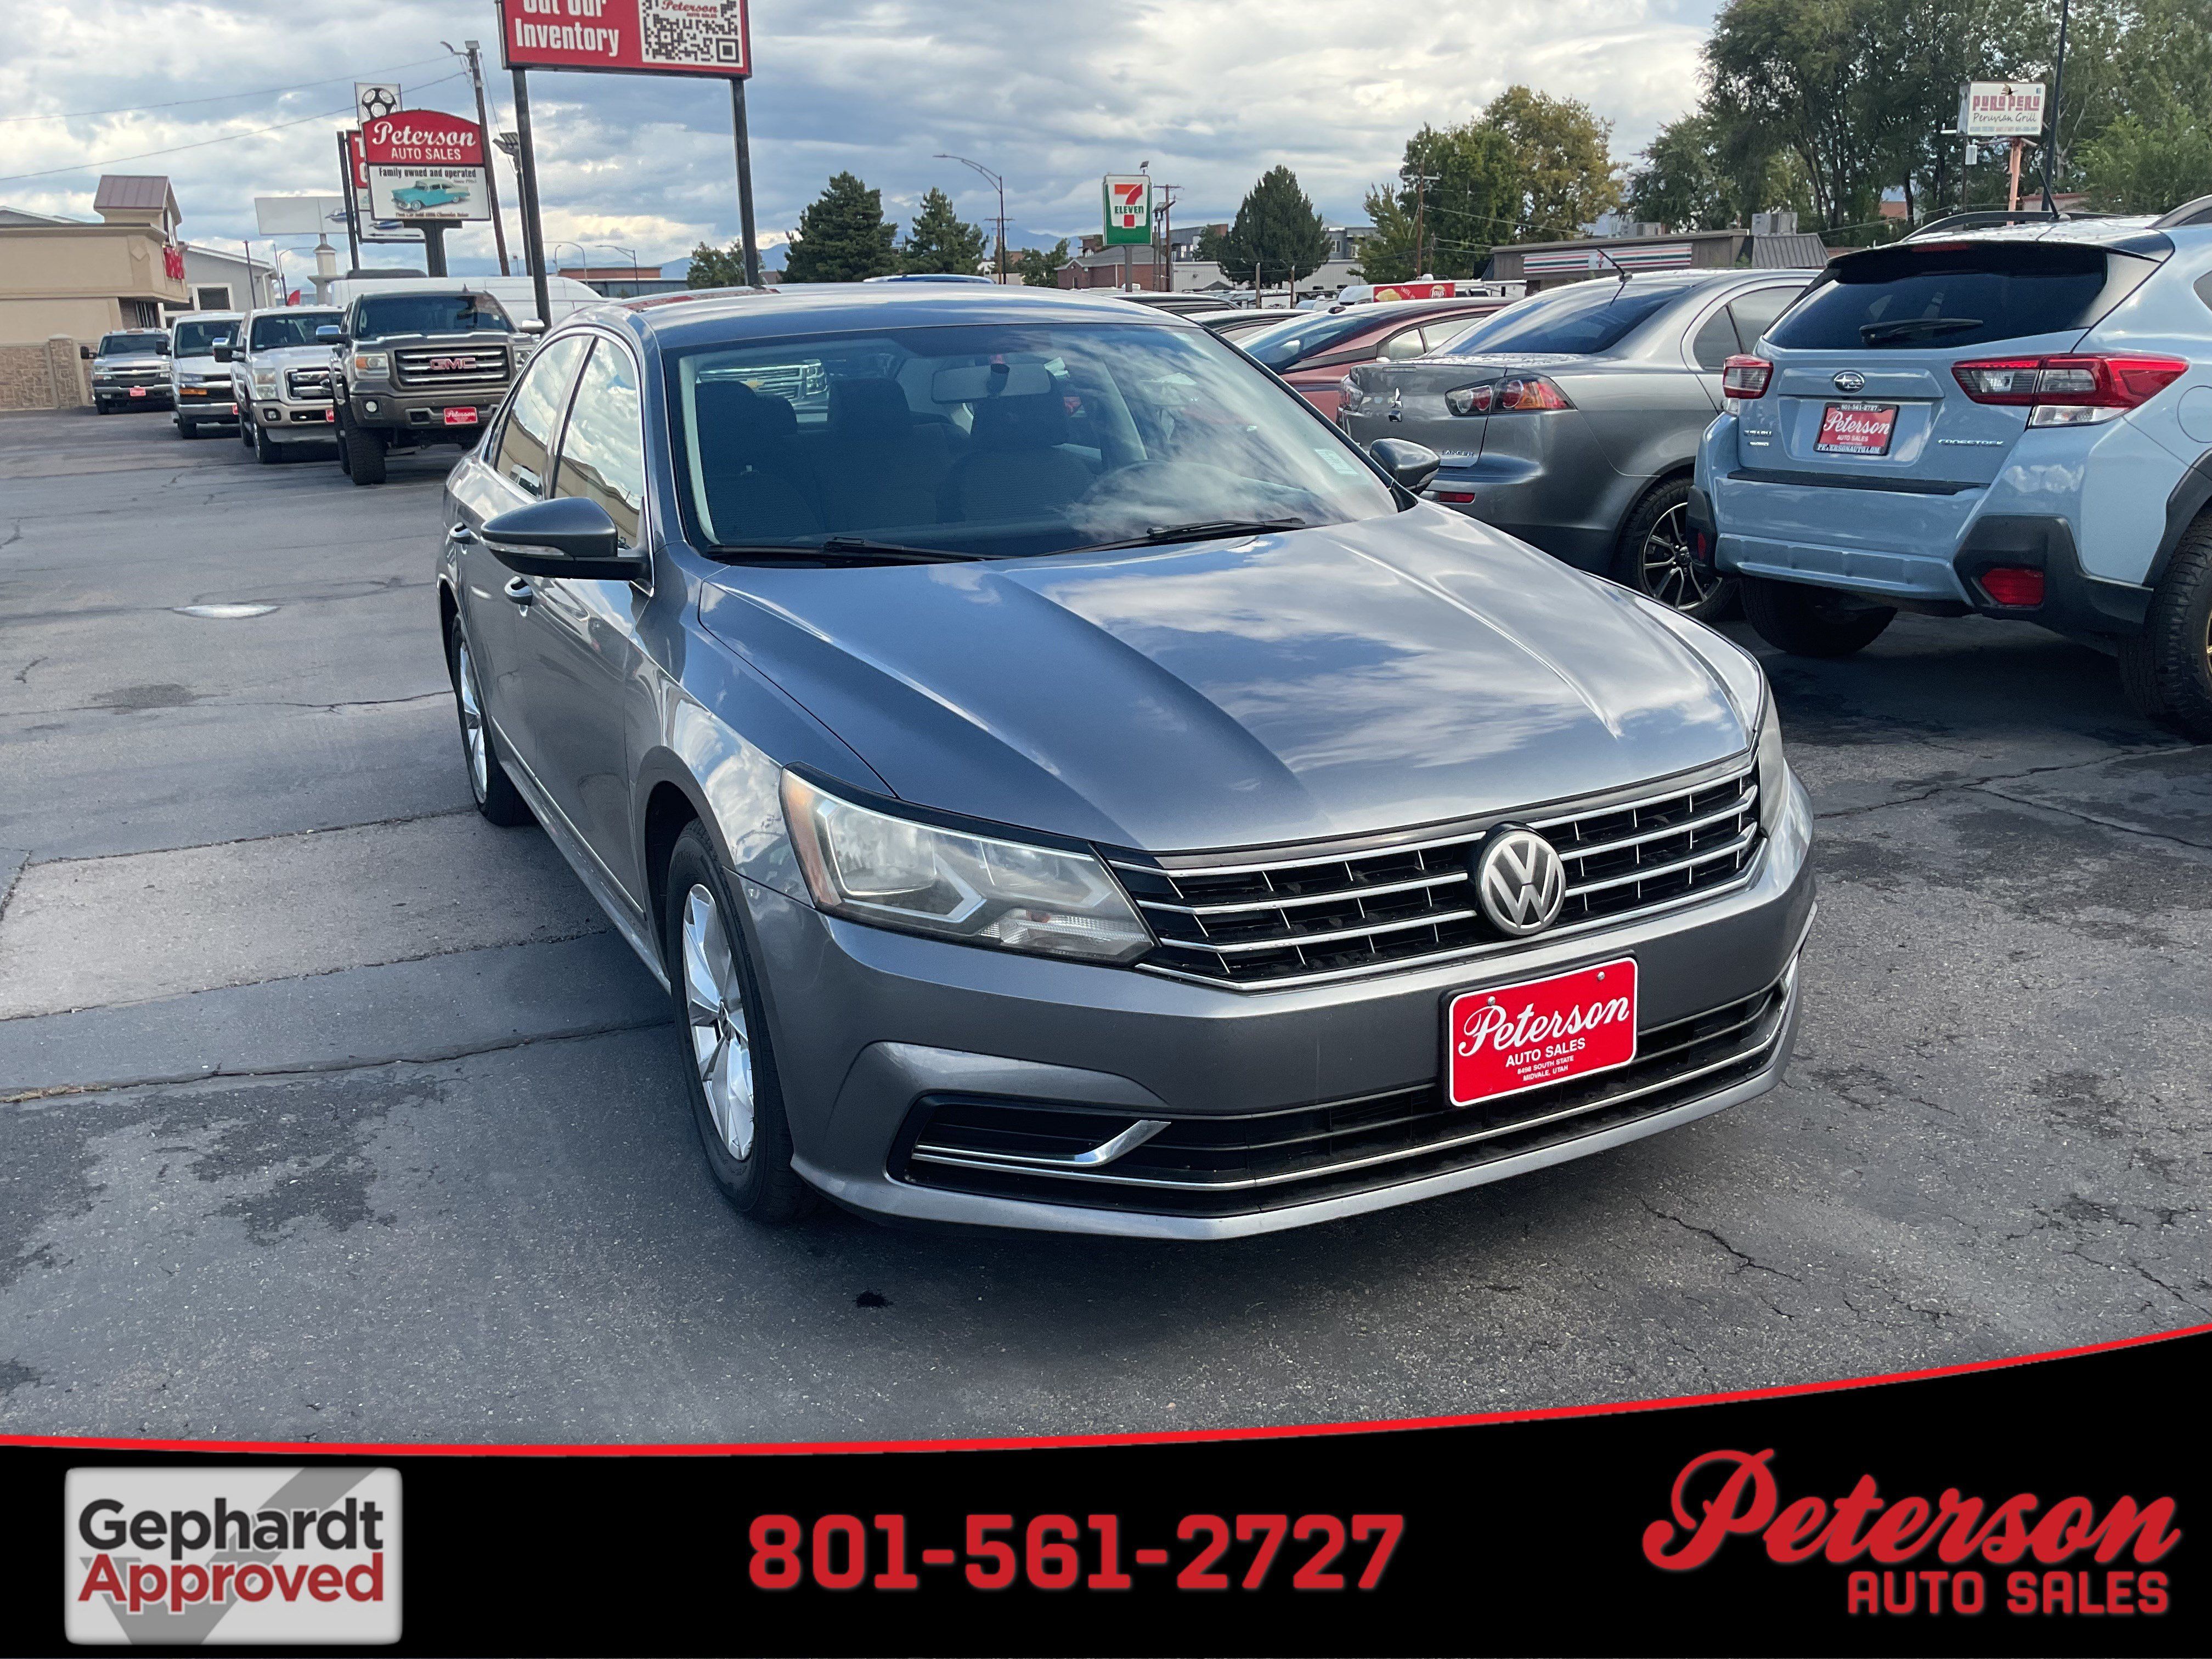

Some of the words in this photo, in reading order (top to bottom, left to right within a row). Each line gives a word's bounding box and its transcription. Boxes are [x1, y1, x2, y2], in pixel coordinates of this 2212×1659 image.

[515, 18, 619, 57] Inventory
[1973, 112, 2013, 123] Peruvian
[2016, 112, 2036, 122] Grill
[373, 121, 476, 146] Peterson
[391, 148, 421, 160] AUTO
[425, 148, 461, 160] SALES
[379, 167, 402, 178] Family
[404, 168, 427, 177] owned
[430, 168, 443, 177] and
[445, 168, 477, 179] operated
[430, 358, 477, 370] GMC
[1823, 411, 1891, 435] Peterson
[1458, 997, 1630, 1057] Peterson
[1505, 1048, 1541, 1068] AUTO
[1545, 1037, 1585, 1058] SALES
[1533, 1060, 1555, 1071] SOUTH
[1556, 1055, 1574, 1065] STATE
[1553, 1065, 1568, 1074] UTAH
